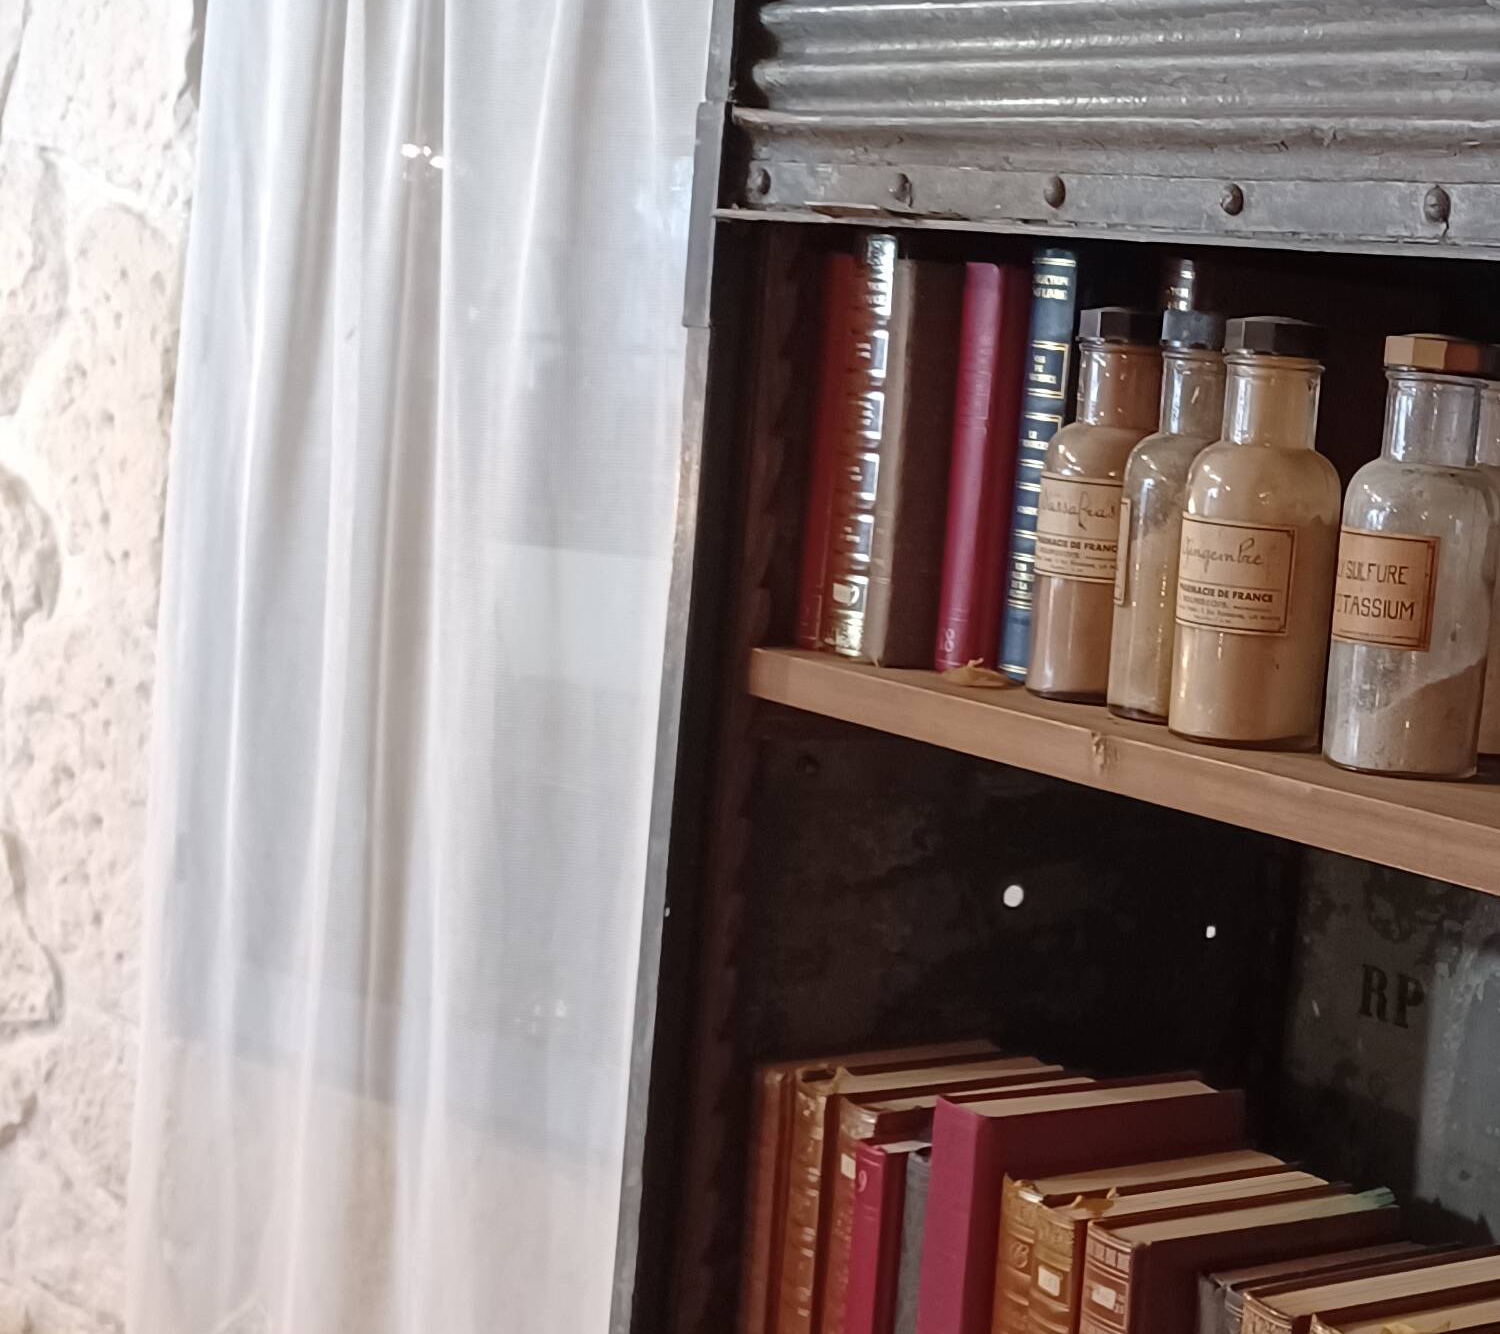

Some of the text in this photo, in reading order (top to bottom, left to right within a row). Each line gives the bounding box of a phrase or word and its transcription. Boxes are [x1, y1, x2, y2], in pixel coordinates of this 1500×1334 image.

[1084, 542, 1118, 553] FRANC
[1217, 589, 1229, 599] DE
[1232, 591, 1274, 603] FRANCE
[1358, 963, 1426, 1029] RP
